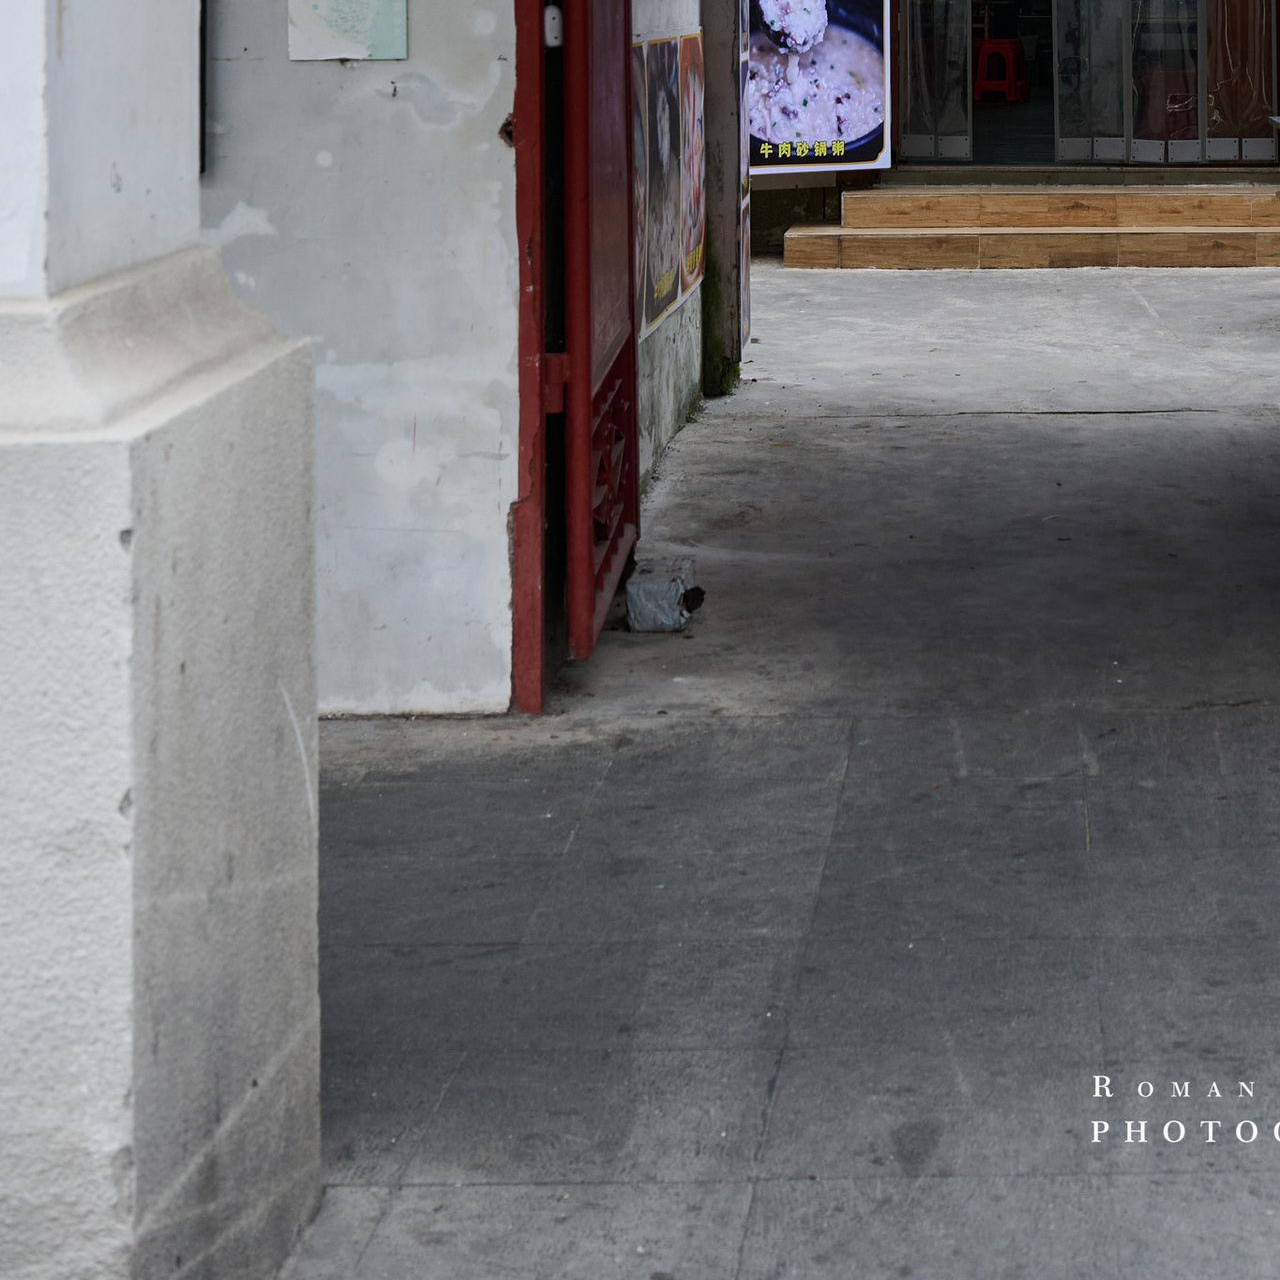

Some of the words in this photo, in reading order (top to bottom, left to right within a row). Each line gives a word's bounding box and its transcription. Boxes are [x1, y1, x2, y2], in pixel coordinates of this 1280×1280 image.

[759, 141, 845, 159] 牛肉砂锅粥
